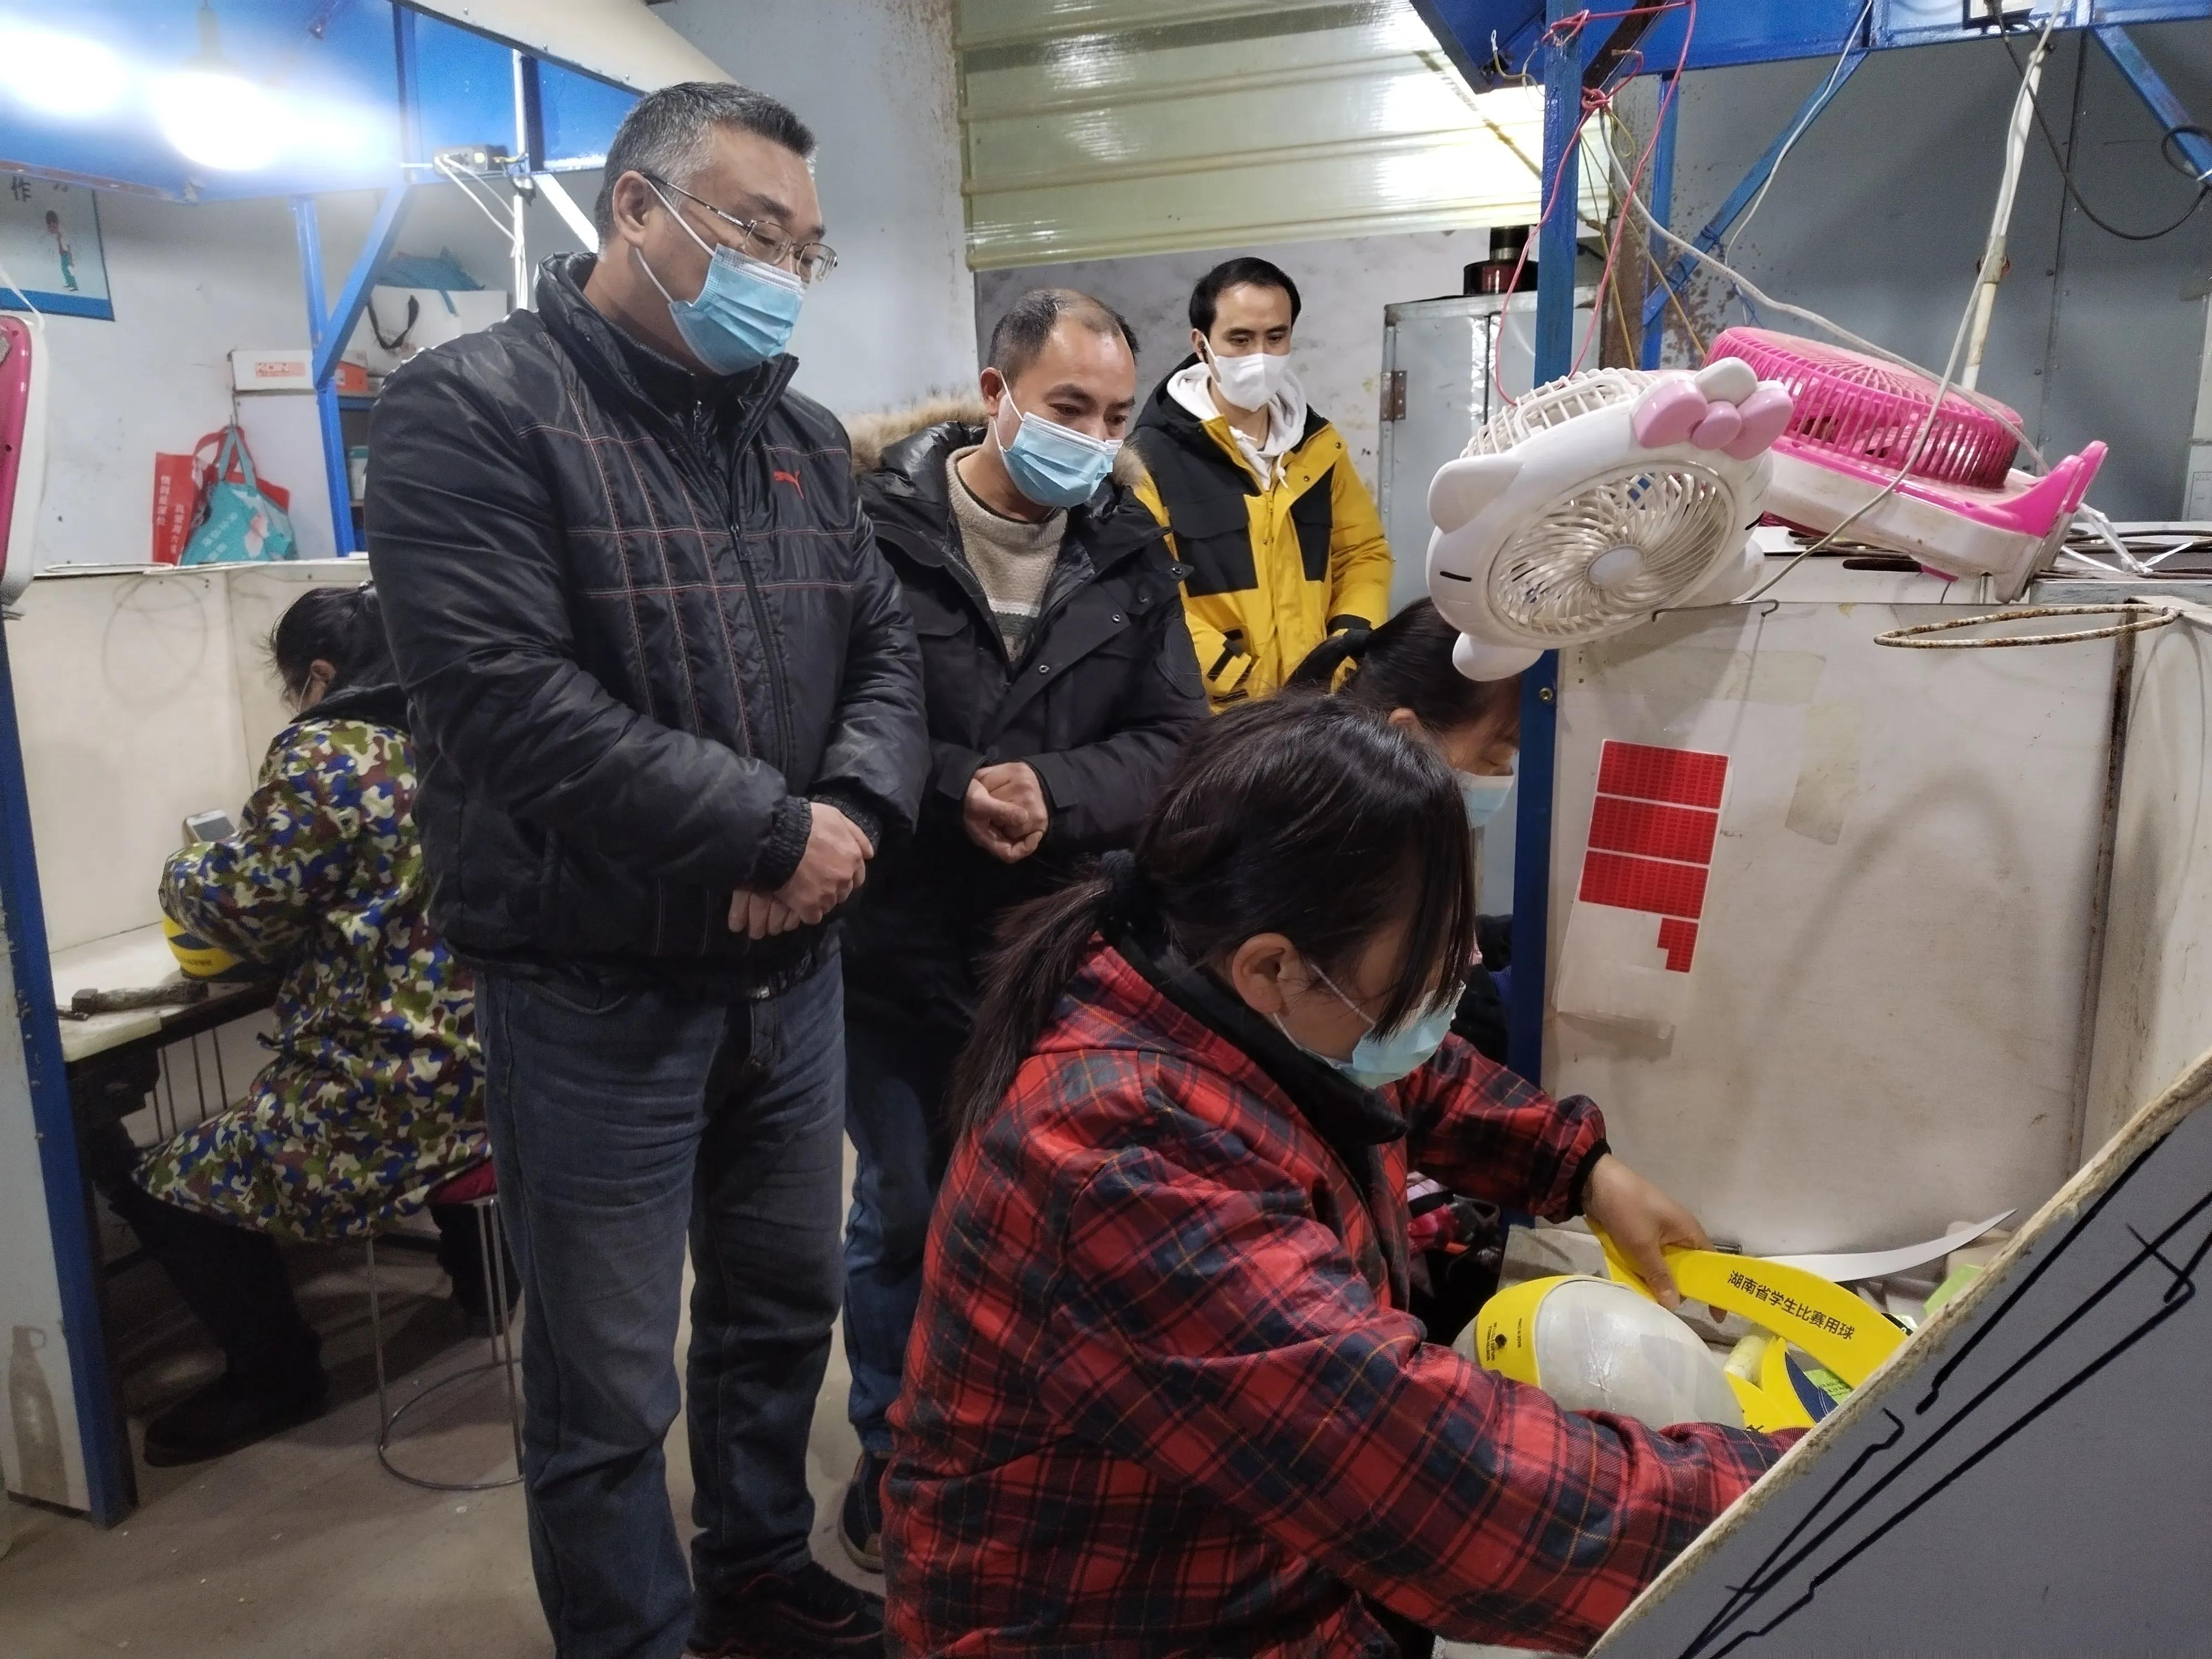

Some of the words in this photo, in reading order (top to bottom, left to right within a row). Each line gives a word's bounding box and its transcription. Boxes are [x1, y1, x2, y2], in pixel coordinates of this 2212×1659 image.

[1726, 1270, 1855, 1340] 湖南省学生比赛用球
